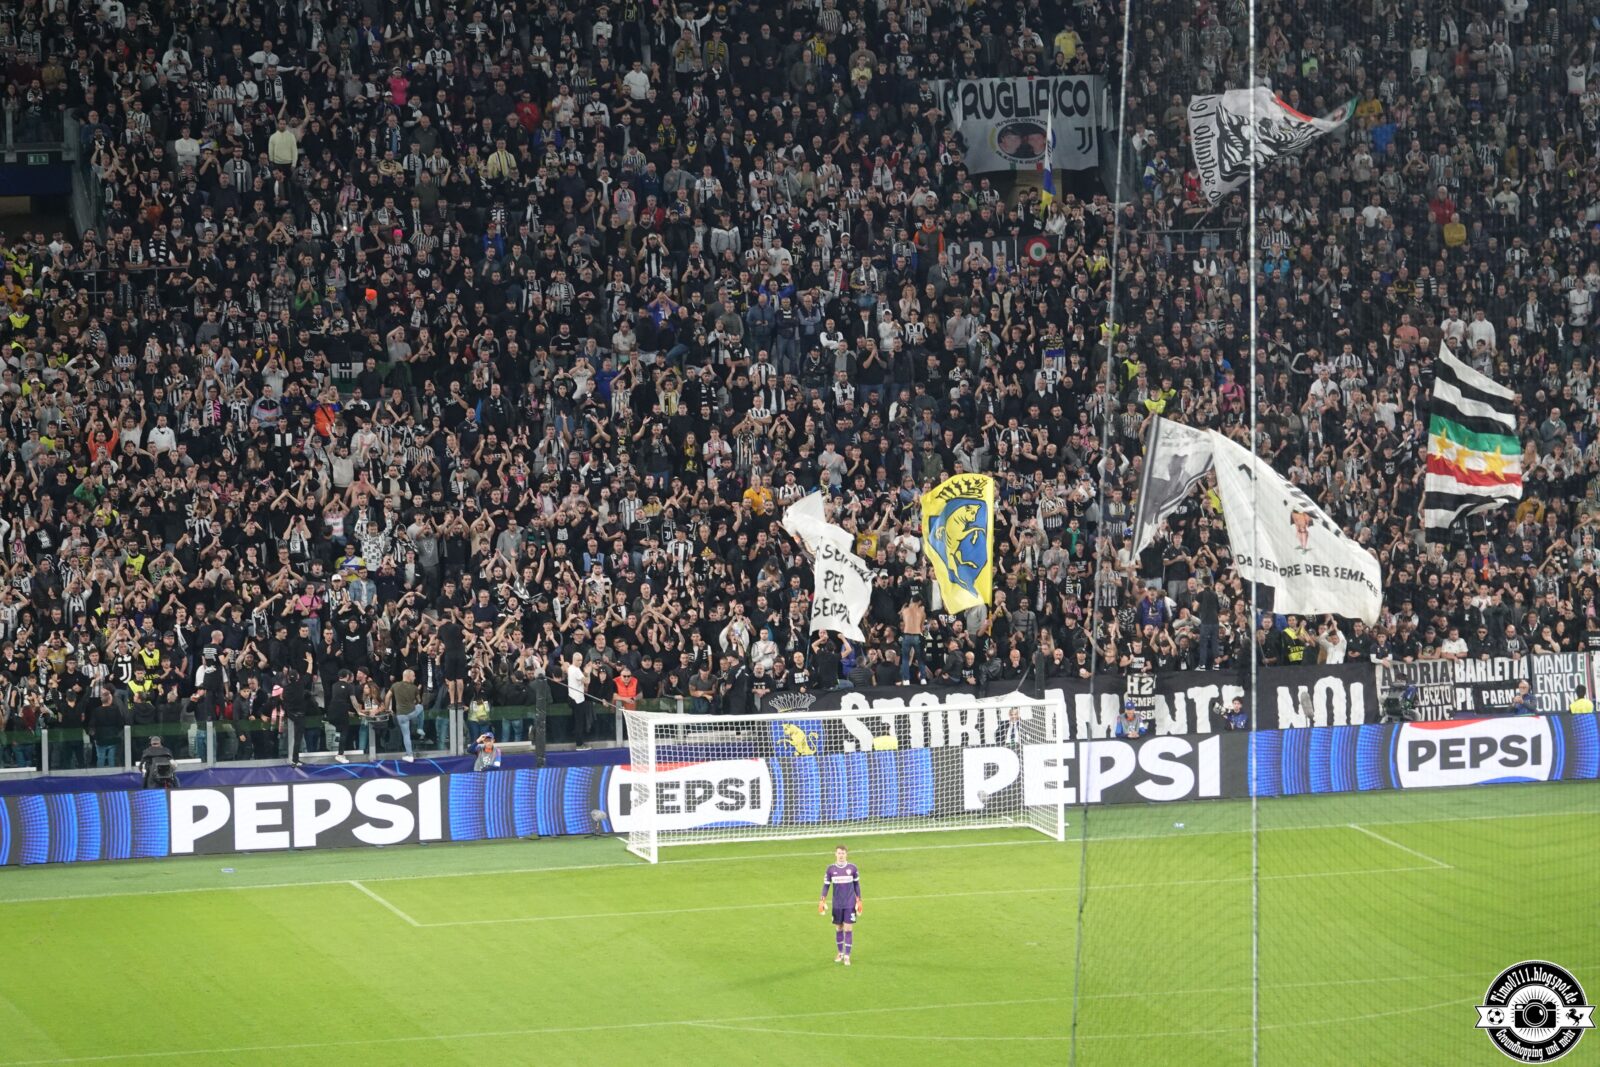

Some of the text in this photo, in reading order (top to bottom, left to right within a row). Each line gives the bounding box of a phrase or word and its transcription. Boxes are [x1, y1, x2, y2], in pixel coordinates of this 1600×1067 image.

[824, 569, 844, 594] PER
[1305, 563, 1331, 578] PER
[1455, 654, 1530, 683] BARLETTA
[1536, 673, 1583, 693] ENRICO
[1277, 675, 1366, 729] NOI
[1535, 693, 1561, 712] CON
[1408, 734, 1542, 772] PEPSI
[963, 735, 1221, 811] PEPSI
[619, 776, 761, 816] PEPSI
[170, 775, 443, 854] PEPSI
